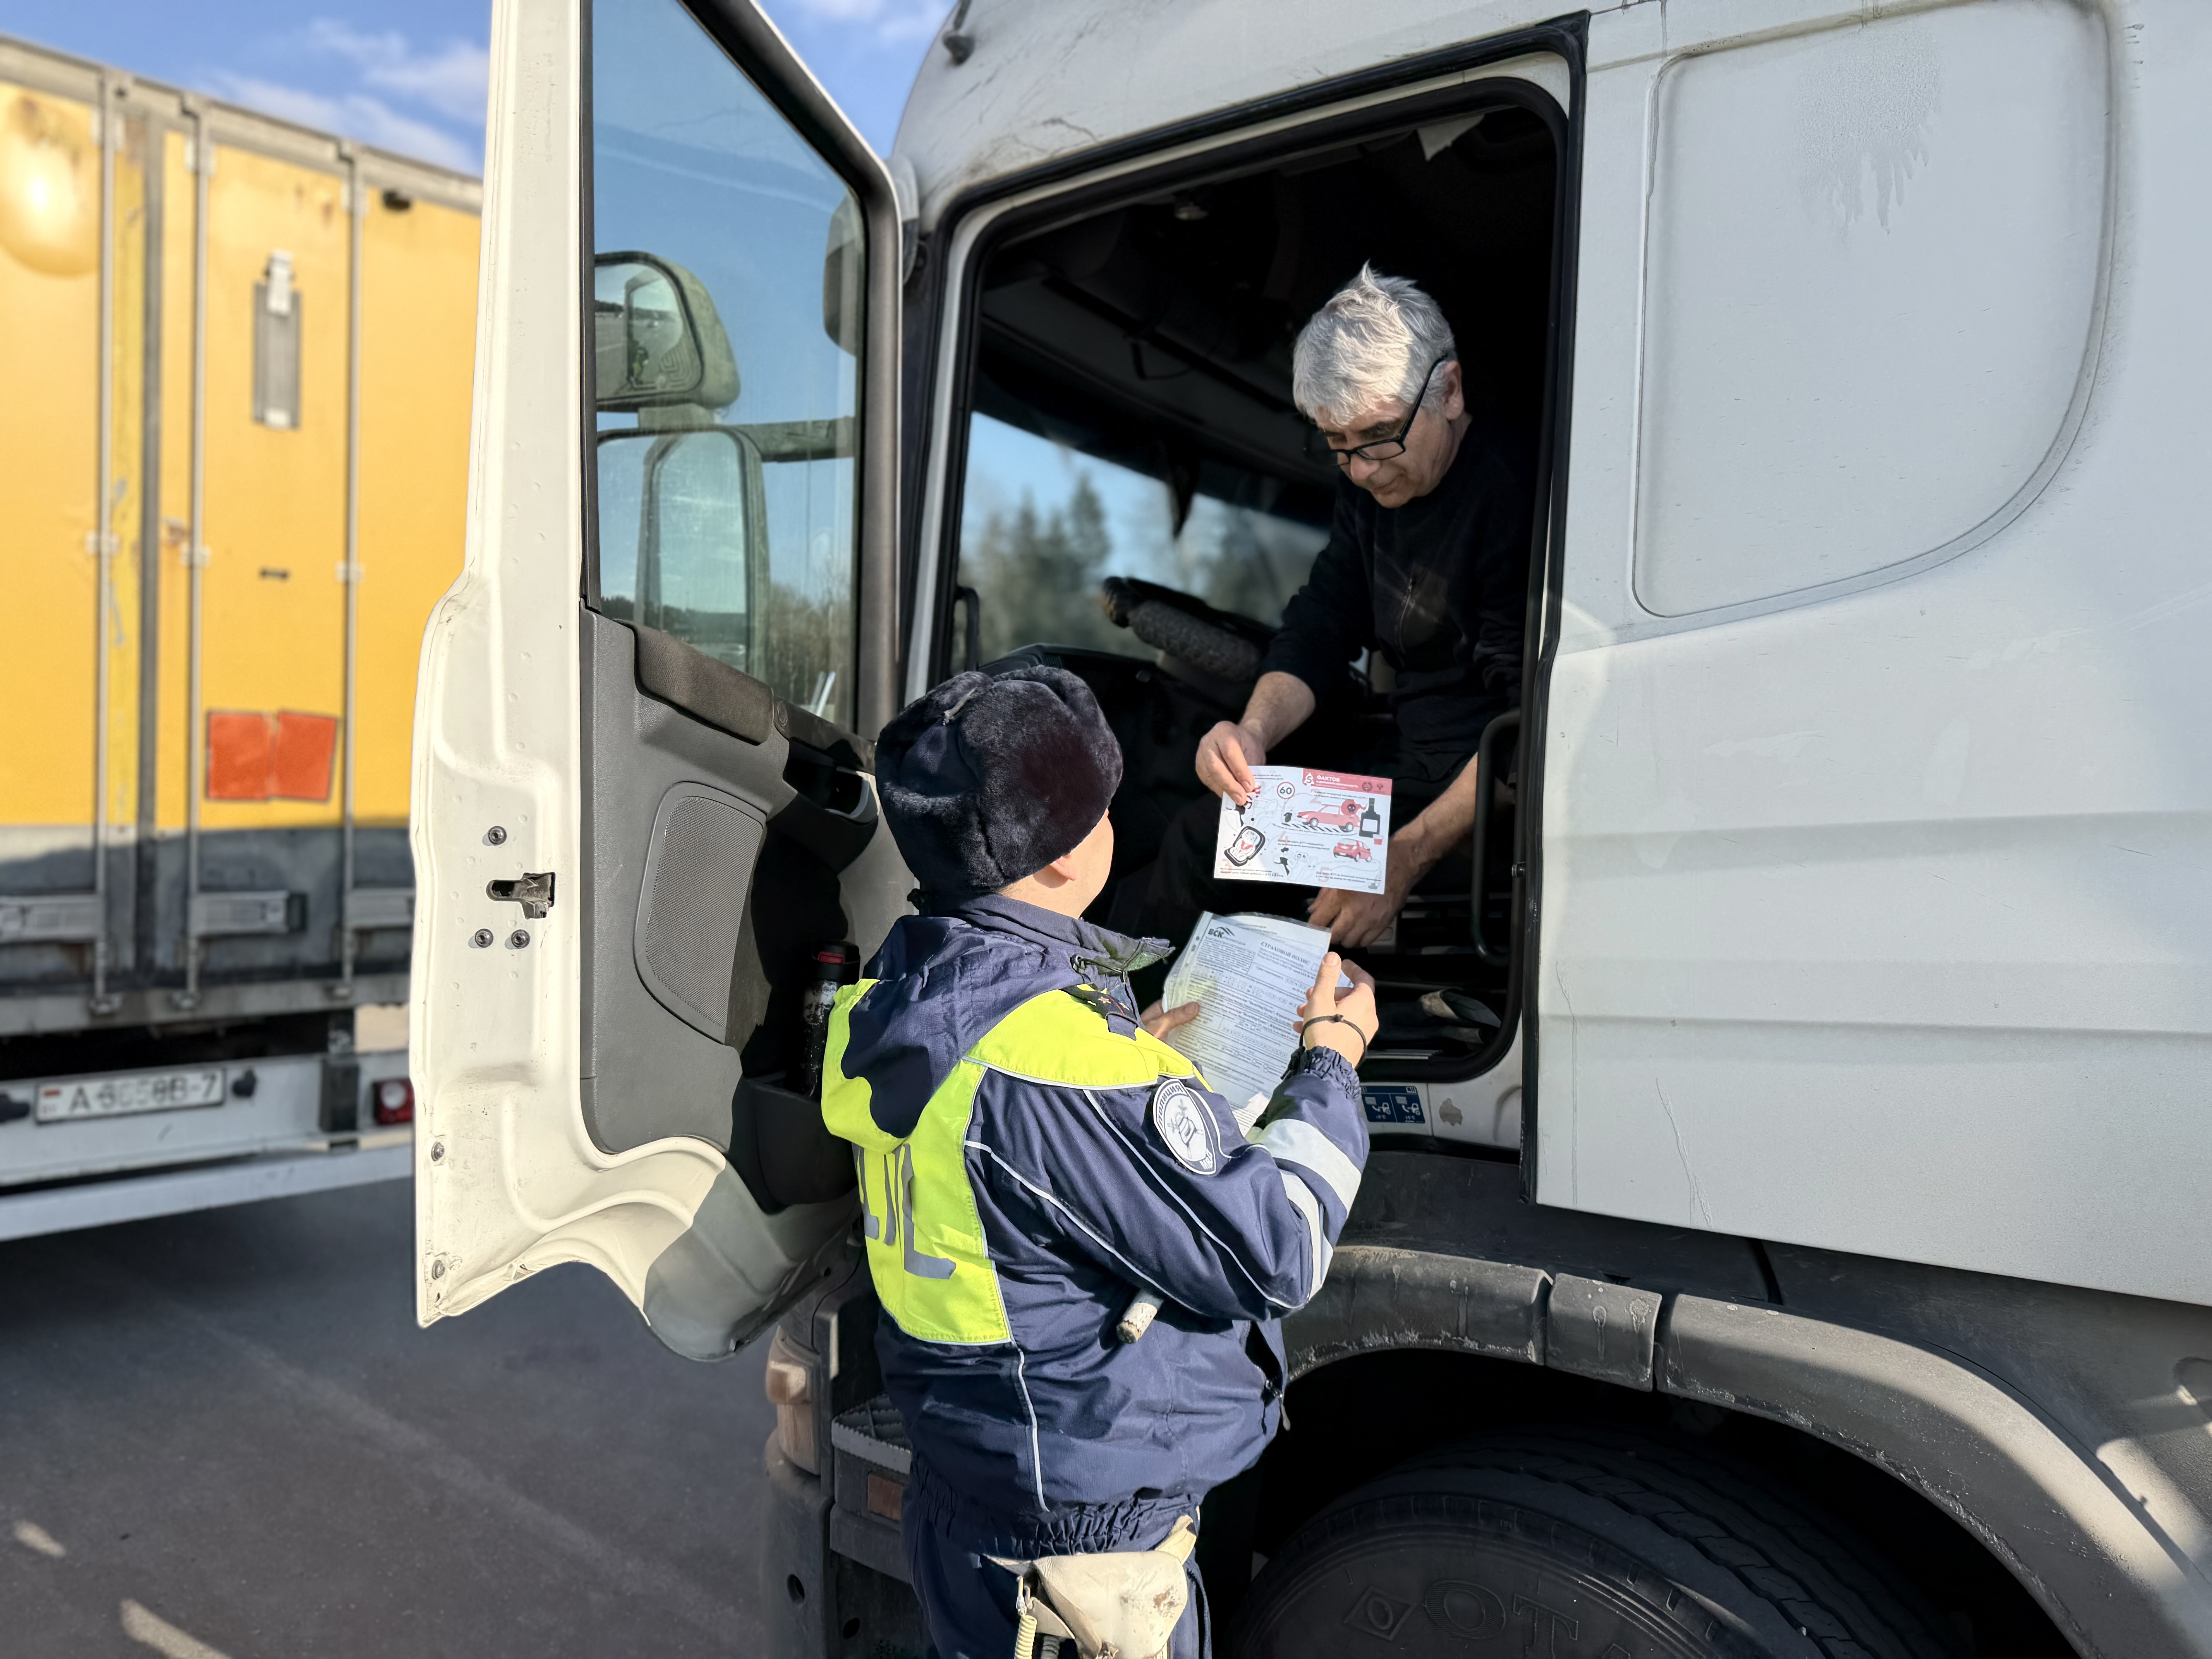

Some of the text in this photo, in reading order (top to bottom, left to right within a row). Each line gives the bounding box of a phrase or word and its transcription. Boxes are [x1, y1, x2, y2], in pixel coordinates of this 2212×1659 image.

[1207, 928, 1225, 938] ВСК
[1261, 941, 1291, 957] СТРАХОВОЙ
[1291, 955, 1312, 965] ПОЛИС
[1158, 1085, 1183, 1129] ПОЛИЦИЯ
